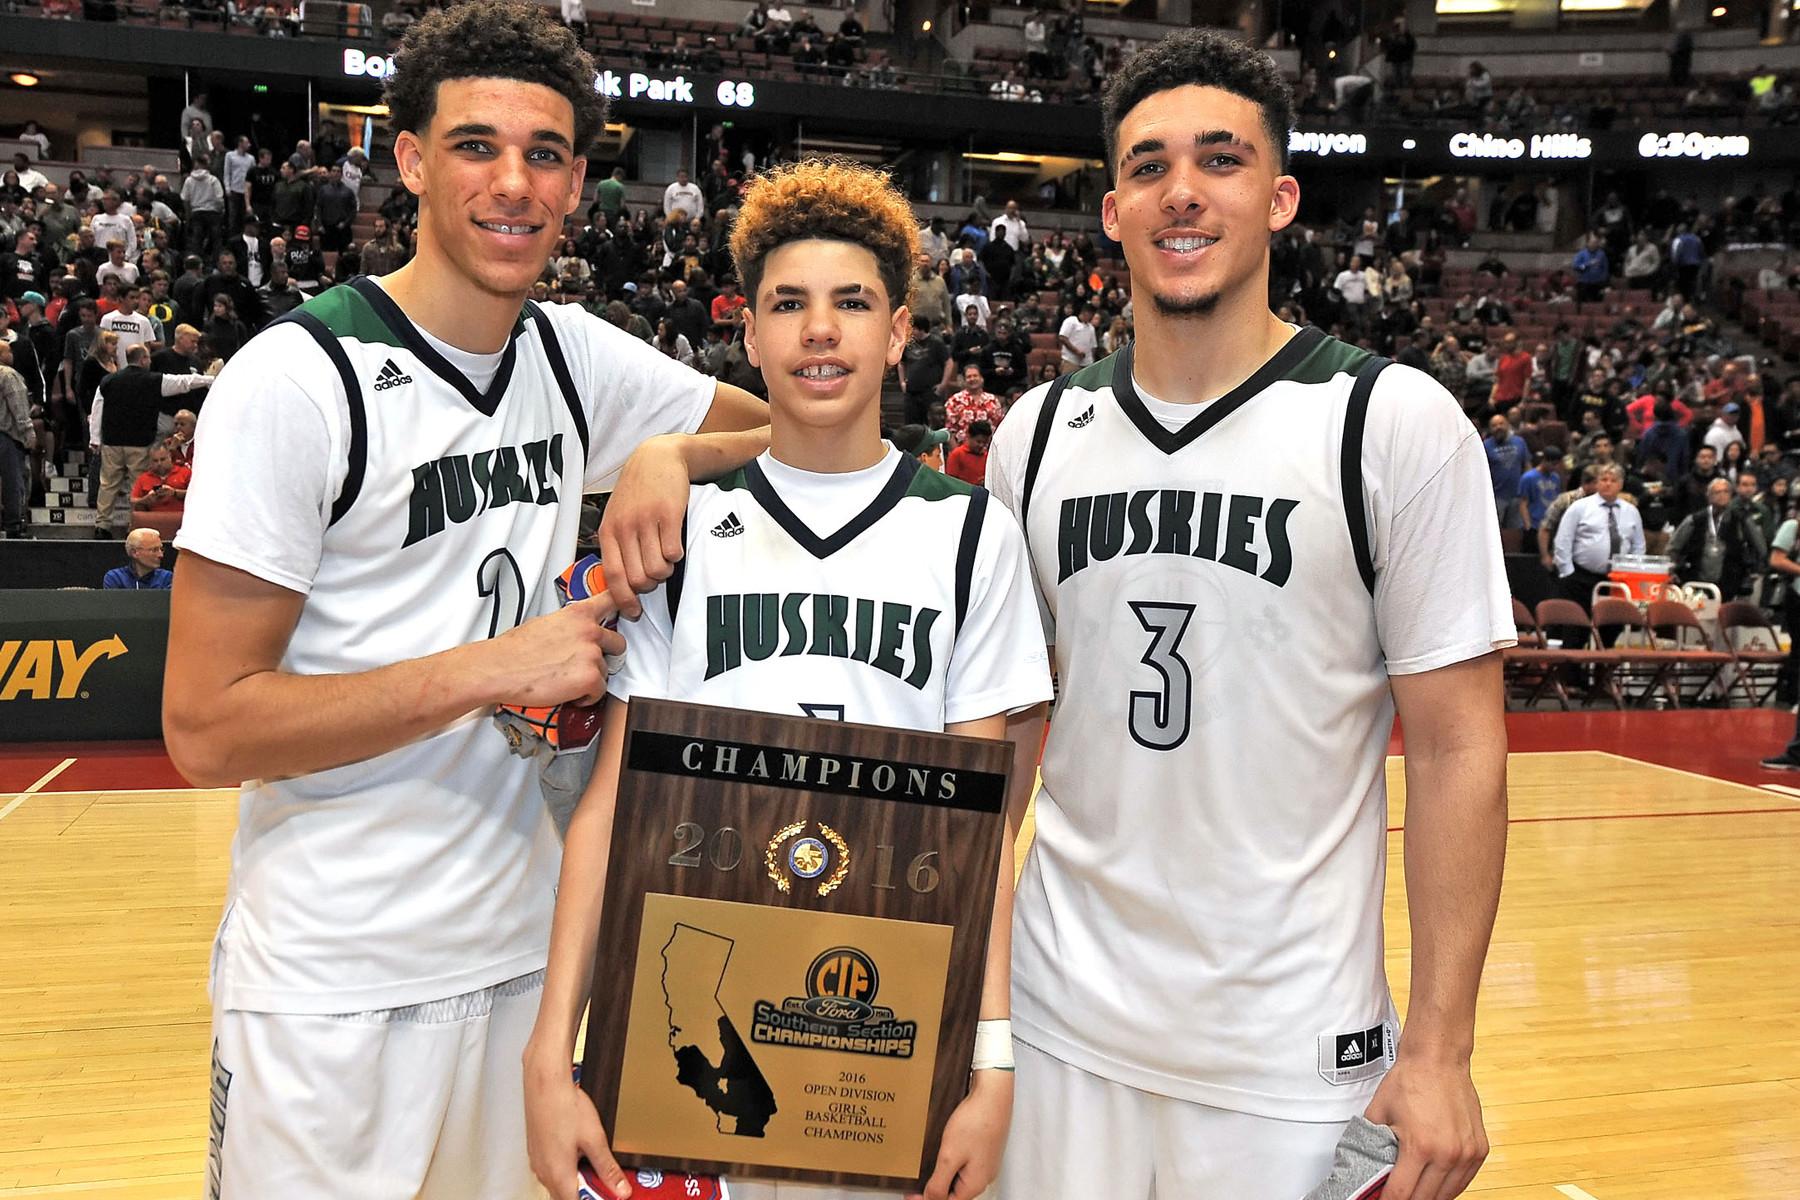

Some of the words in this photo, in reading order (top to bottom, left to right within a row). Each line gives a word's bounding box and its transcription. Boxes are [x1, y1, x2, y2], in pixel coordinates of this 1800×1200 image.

[629, 72, 693, 102] Park
[717, 80, 754, 107] 68
[1449, 132, 1525, 158] Chino
[1530, 133, 1592, 158] Hills
[1639, 132, 1749, 160] 6:30pm
[374, 375, 413, 391] adidas
[710, 525, 745, 538] adidas
[1057, 489, 1301, 589] HUSKIES
[703, 592, 943, 691] HUSKIES
[1126, 600, 1198, 751] 3
[682, 742, 957, 800] CHAMPIONS
[668, 822, 744, 872] 20
[872, 844, 940, 893] 16
[816, 956, 869, 998] CIF
[757, 1004, 838, 1036] Southern
[847, 1022, 914, 1039] Section
[816, 999, 861, 1020] Ford
[753, 1022, 912, 1057] CHAMPIONSHIPS
[803, 1083, 838, 1097] OPEN
[840, 1087, 896, 1102] DIVISION
[838, 1072, 866, 1083] 2016
[805, 1110, 886, 1128] BASKETBALL
[828, 1102, 868, 1116] GIRLS
[804, 1127, 884, 1144] CHAMPIONS
